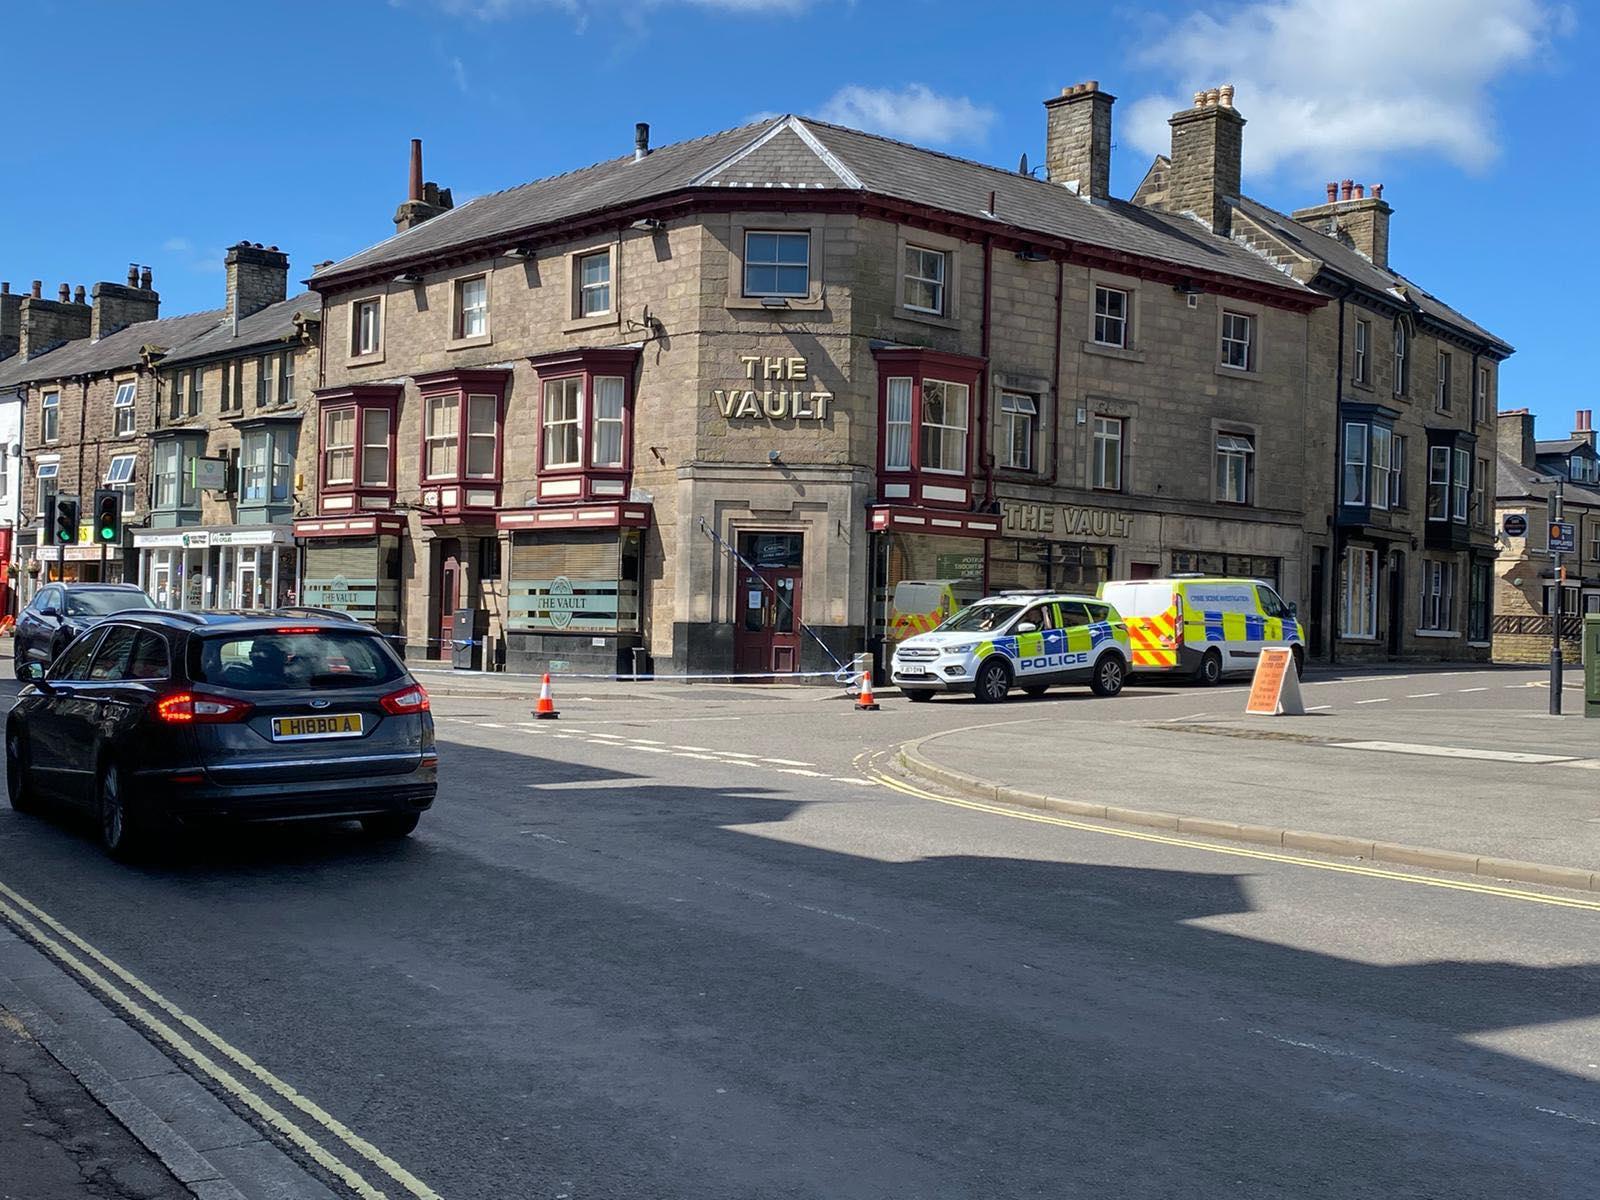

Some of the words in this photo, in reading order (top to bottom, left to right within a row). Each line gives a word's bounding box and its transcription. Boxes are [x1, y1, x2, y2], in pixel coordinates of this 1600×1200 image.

[740, 355, 808, 381] THE
[713, 389, 835, 420] VAULT
[1004, 502, 1055, 533] THE
[1063, 506, 1134, 539] VAULT
[321, 592, 335, 602] THE
[336, 592, 358, 602] VAULT
[537, 597, 555, 609] THE
[557, 597, 587, 609] VAULT
[1020, 653, 1088, 670] POLICE
[343, 717, 352, 732] A
